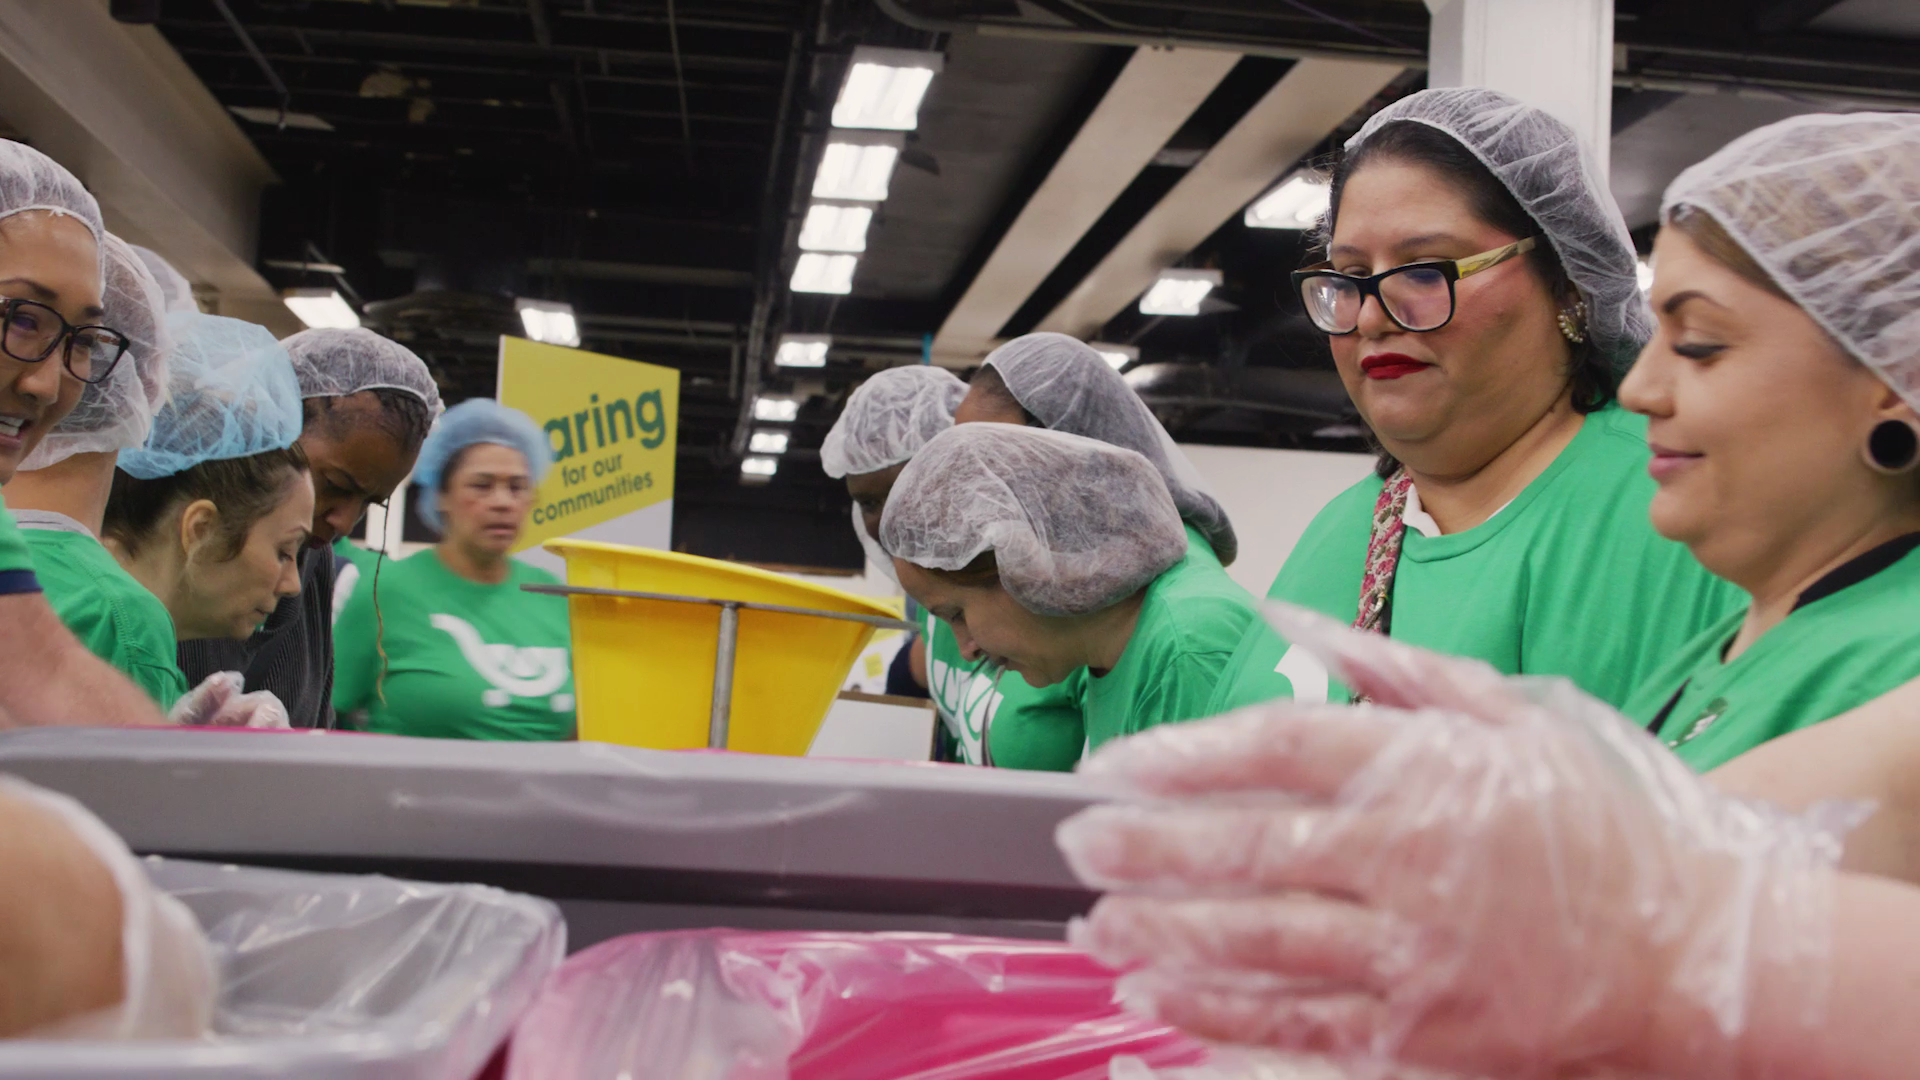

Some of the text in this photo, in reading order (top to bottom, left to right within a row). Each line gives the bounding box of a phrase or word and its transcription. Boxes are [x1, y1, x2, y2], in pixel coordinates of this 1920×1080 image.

[543, 388, 666, 463] aring
[562, 453, 622, 487] for our
[533, 471, 653, 525] communities
